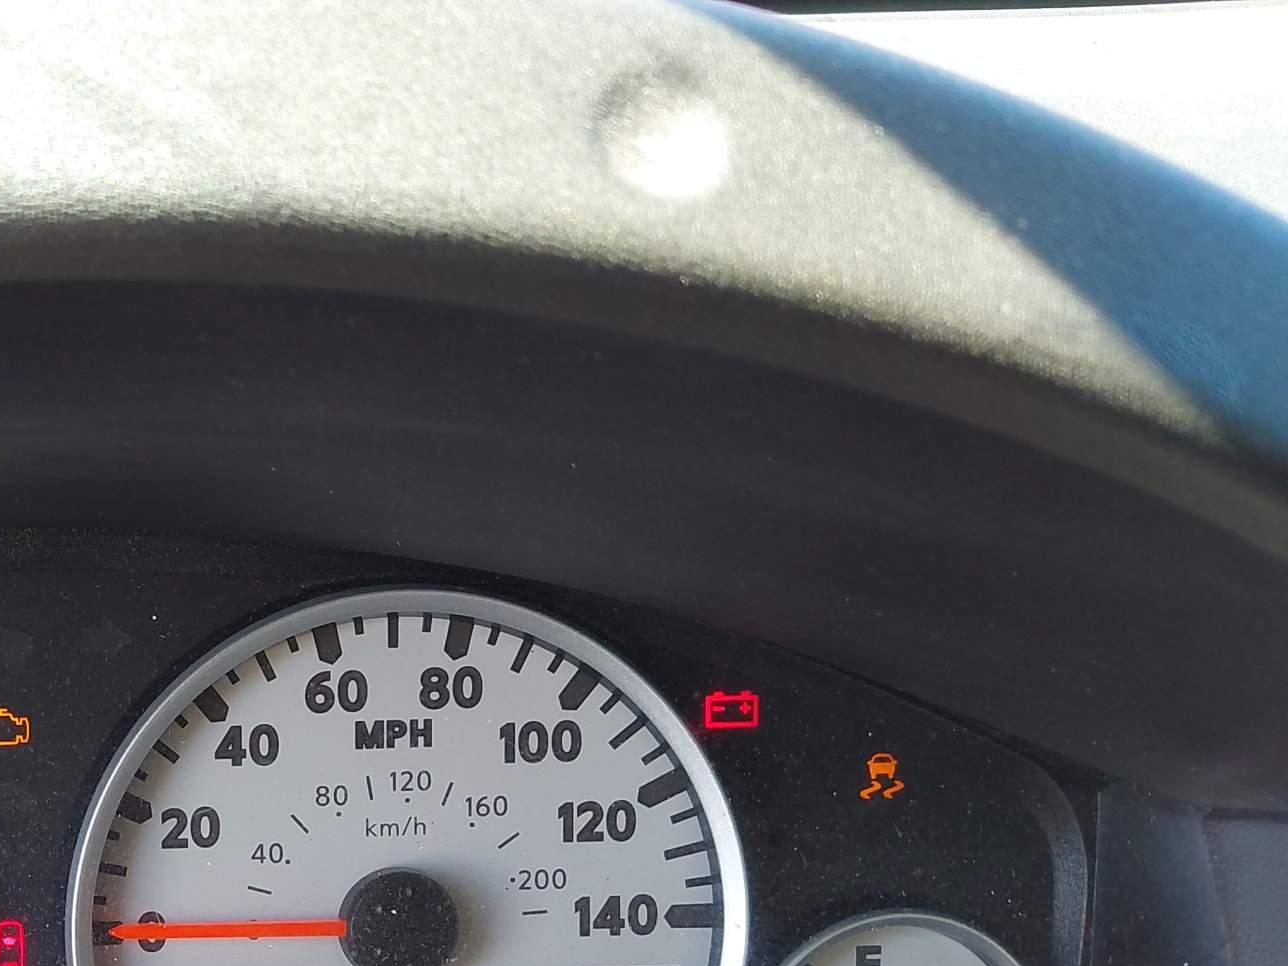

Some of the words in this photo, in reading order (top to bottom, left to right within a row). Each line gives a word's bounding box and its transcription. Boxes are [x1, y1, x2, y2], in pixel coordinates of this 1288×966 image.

[305, 670, 368, 713] 60
[419, 666, 482, 710] 80
[215, 724, 279, 766] 40
[355, 719, 432, 749] MPH
[500, 720, 582, 763] 100
[315, 786, 348, 806] 80
[389, 771, 432, 792] 120
[466, 796, 508, 816] 160
[557, 801, 636, 843] 120
[161, 807, 220, 849] 20
[365, 816, 427, 838] km/h
[251, 843, 284, 864] 40
[519, 869, 567, 891] 200
[574, 894, 658, 937] 140
